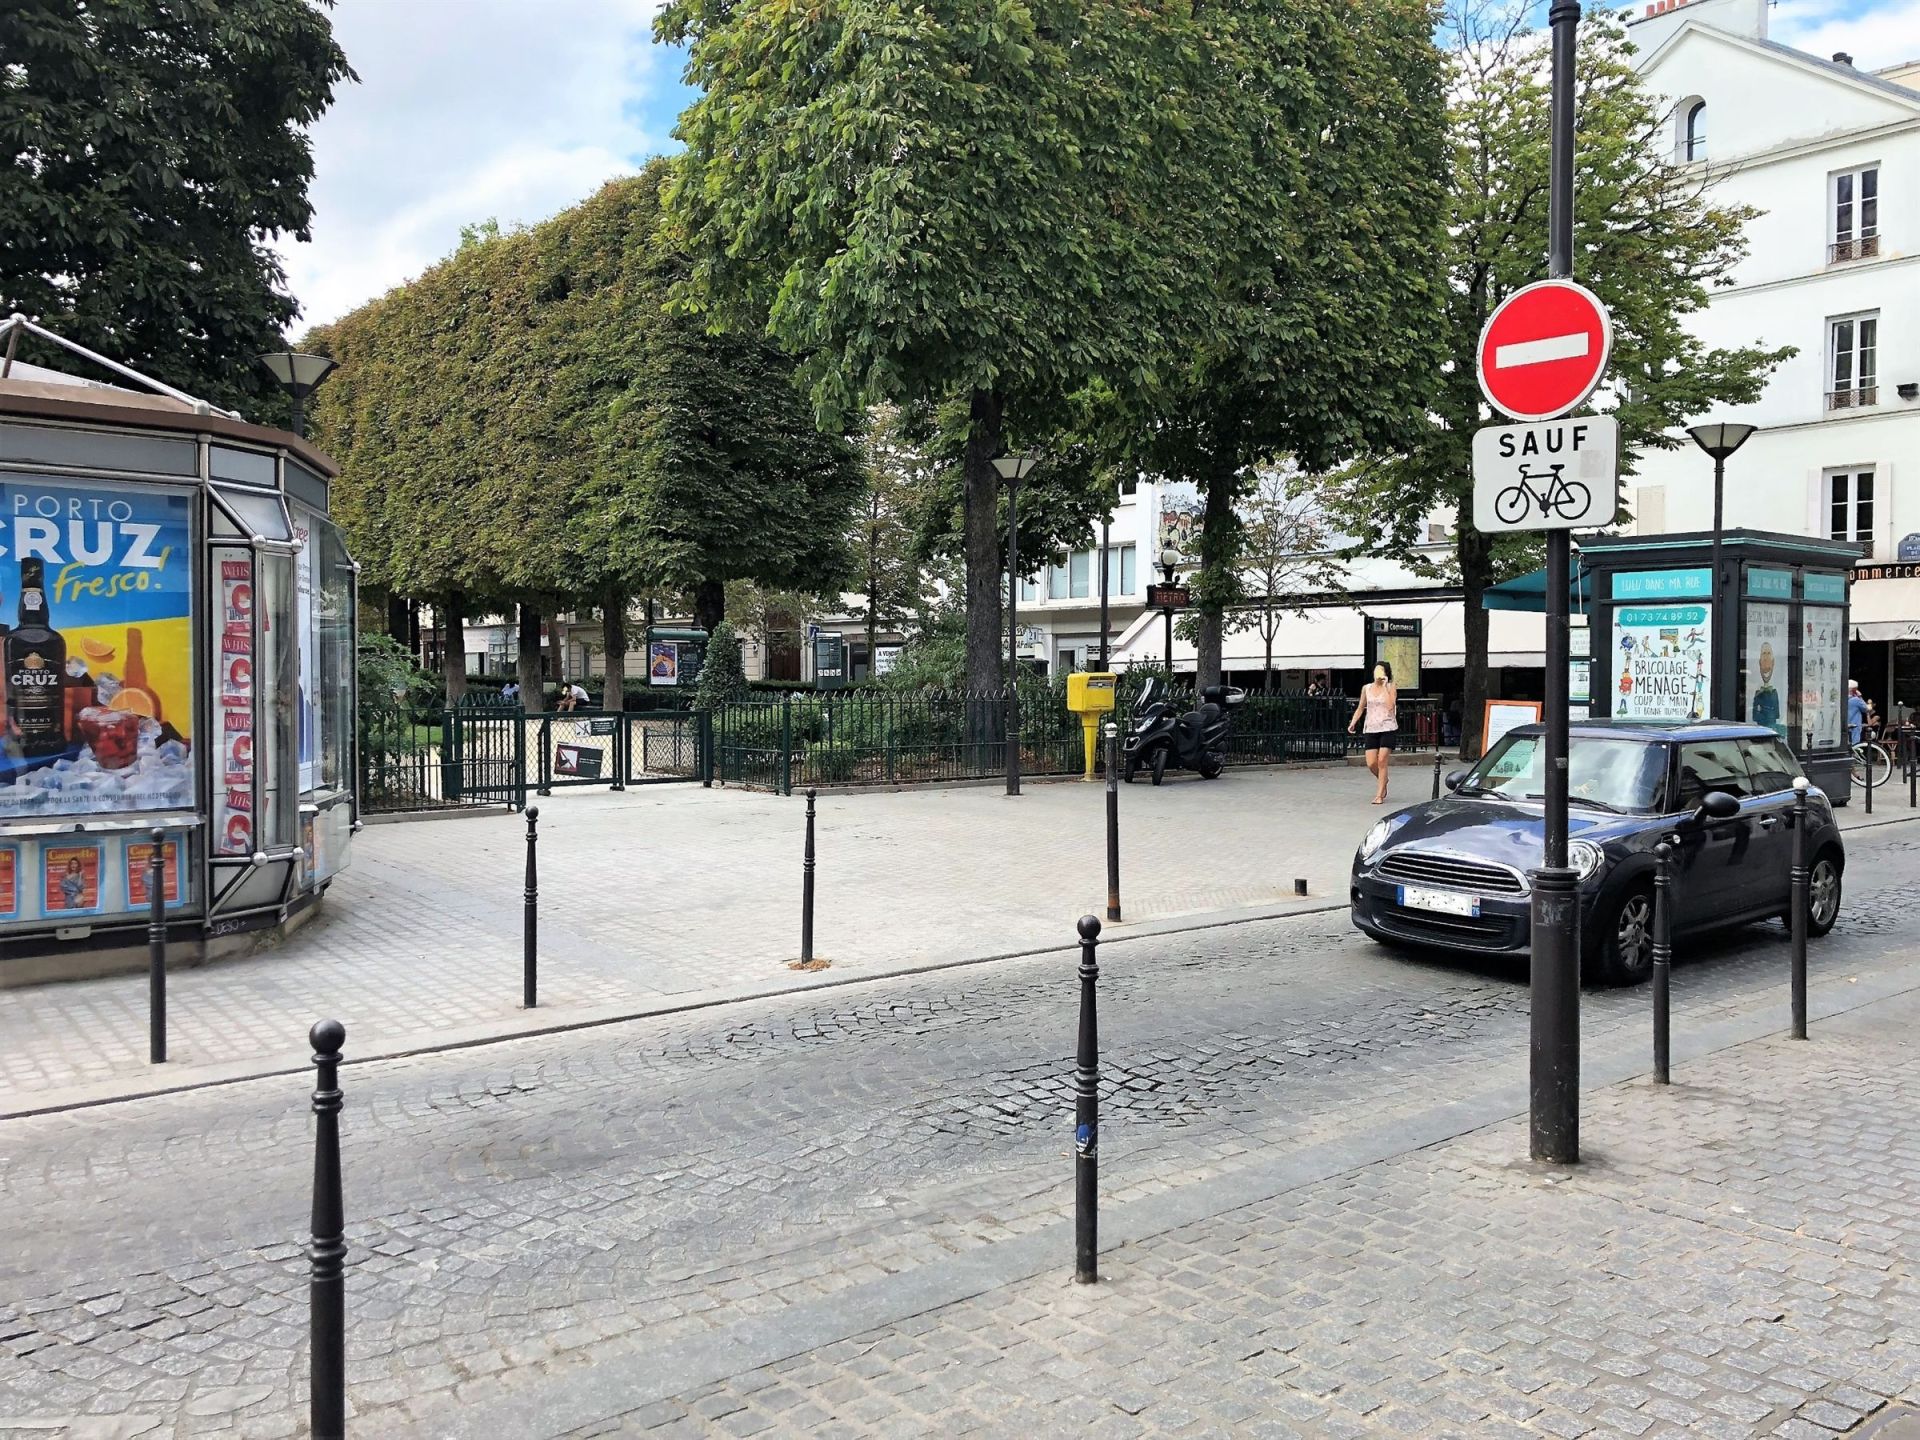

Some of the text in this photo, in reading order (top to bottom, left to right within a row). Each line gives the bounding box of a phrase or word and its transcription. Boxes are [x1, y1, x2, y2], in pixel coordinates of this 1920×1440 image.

[1499, 425, 1588, 457] SAUF
[14, 494, 133, 522] PORTO
[0, 516, 162, 568] RUZ
[1849, 566, 1920, 580] ommerce
[1640, 613, 1653, 622] 73
[1655, 613, 1668, 622] 74
[1670, 612, 1683, 621] 89
[1687, 612, 1698, 620] 52
[1389, 623, 1414, 632] Commerce
[1635, 660, 1690, 676] BRICOLAGE,
[11, 674, 58, 686] CRUZ
[1634, 696, 1688, 706] COUP DE MAIN
